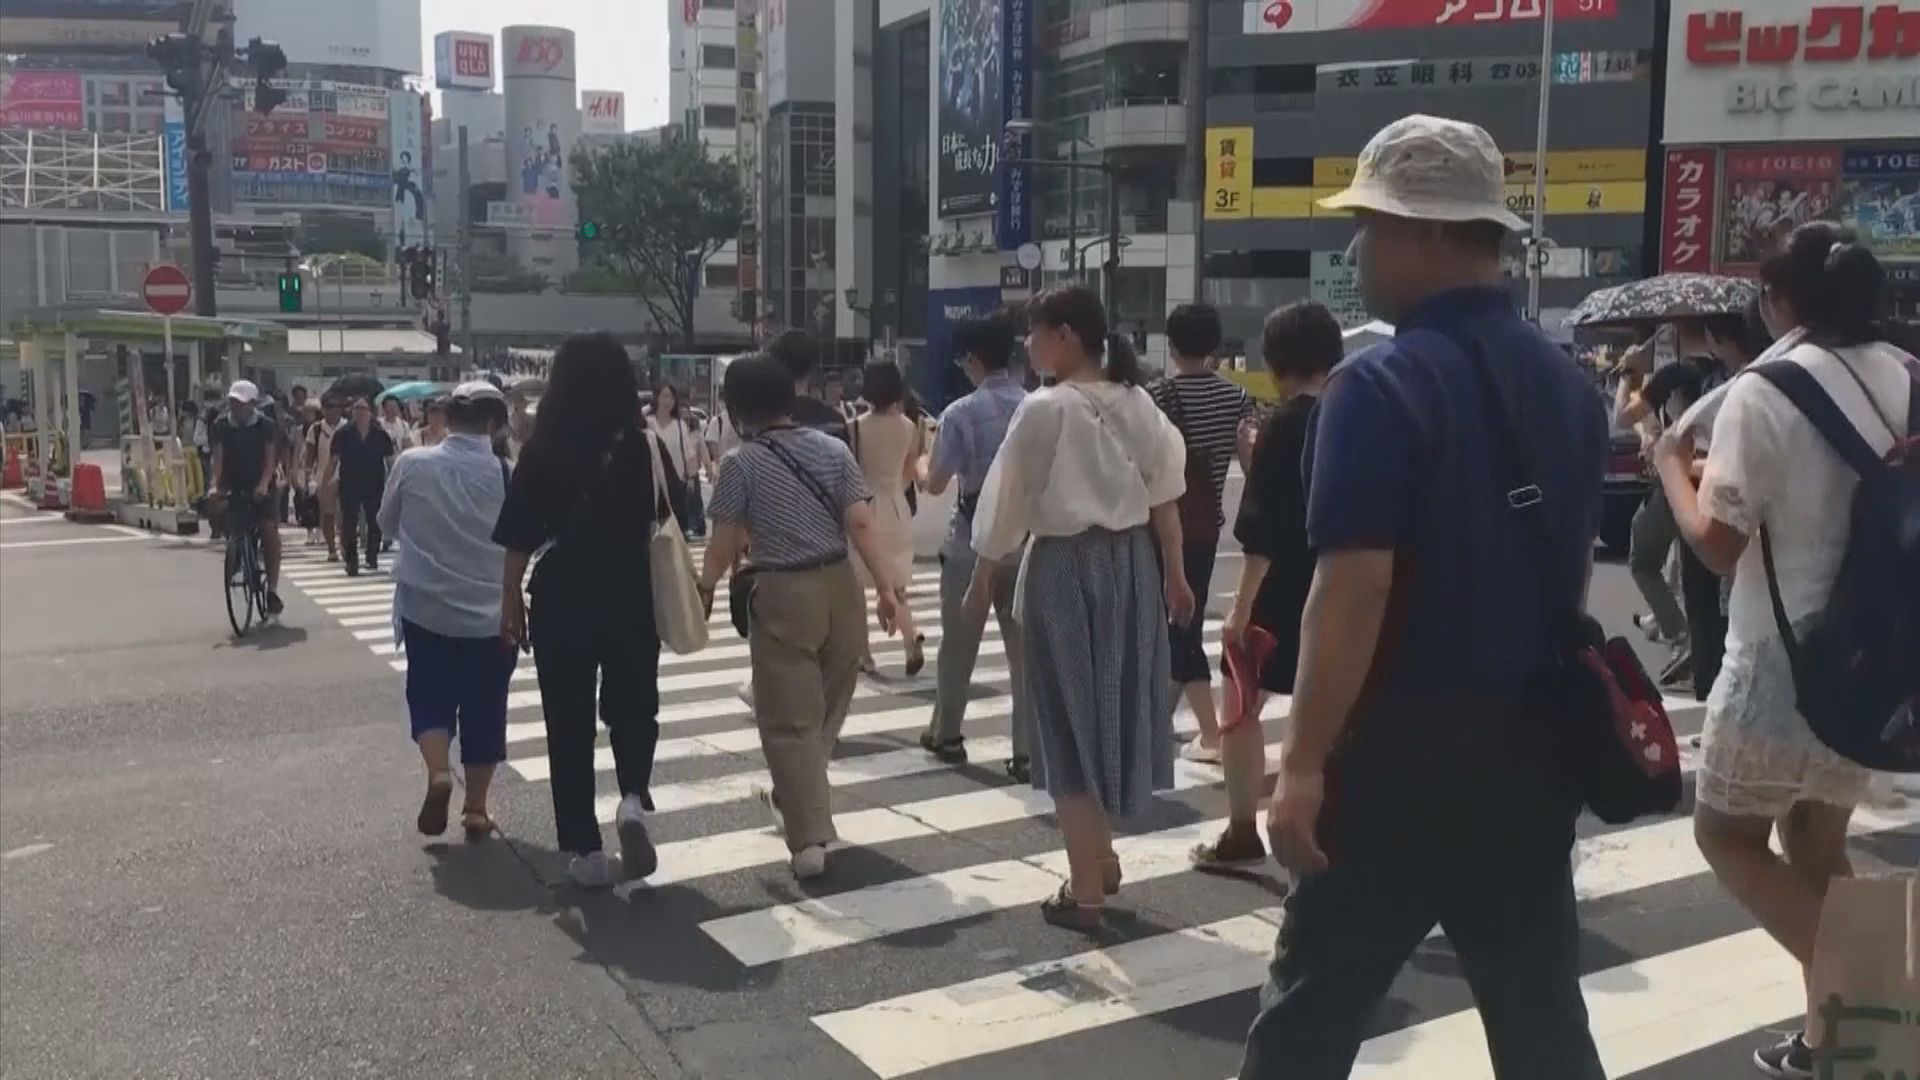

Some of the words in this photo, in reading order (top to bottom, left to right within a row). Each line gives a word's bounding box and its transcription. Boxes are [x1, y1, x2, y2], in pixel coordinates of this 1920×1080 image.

[1728, 80, 1797, 113] BIC
[268, 156, 306, 171] ガスト
[1215, 188, 1240, 209] 3F
[1672, 160, 1704, 265] カラオケ
